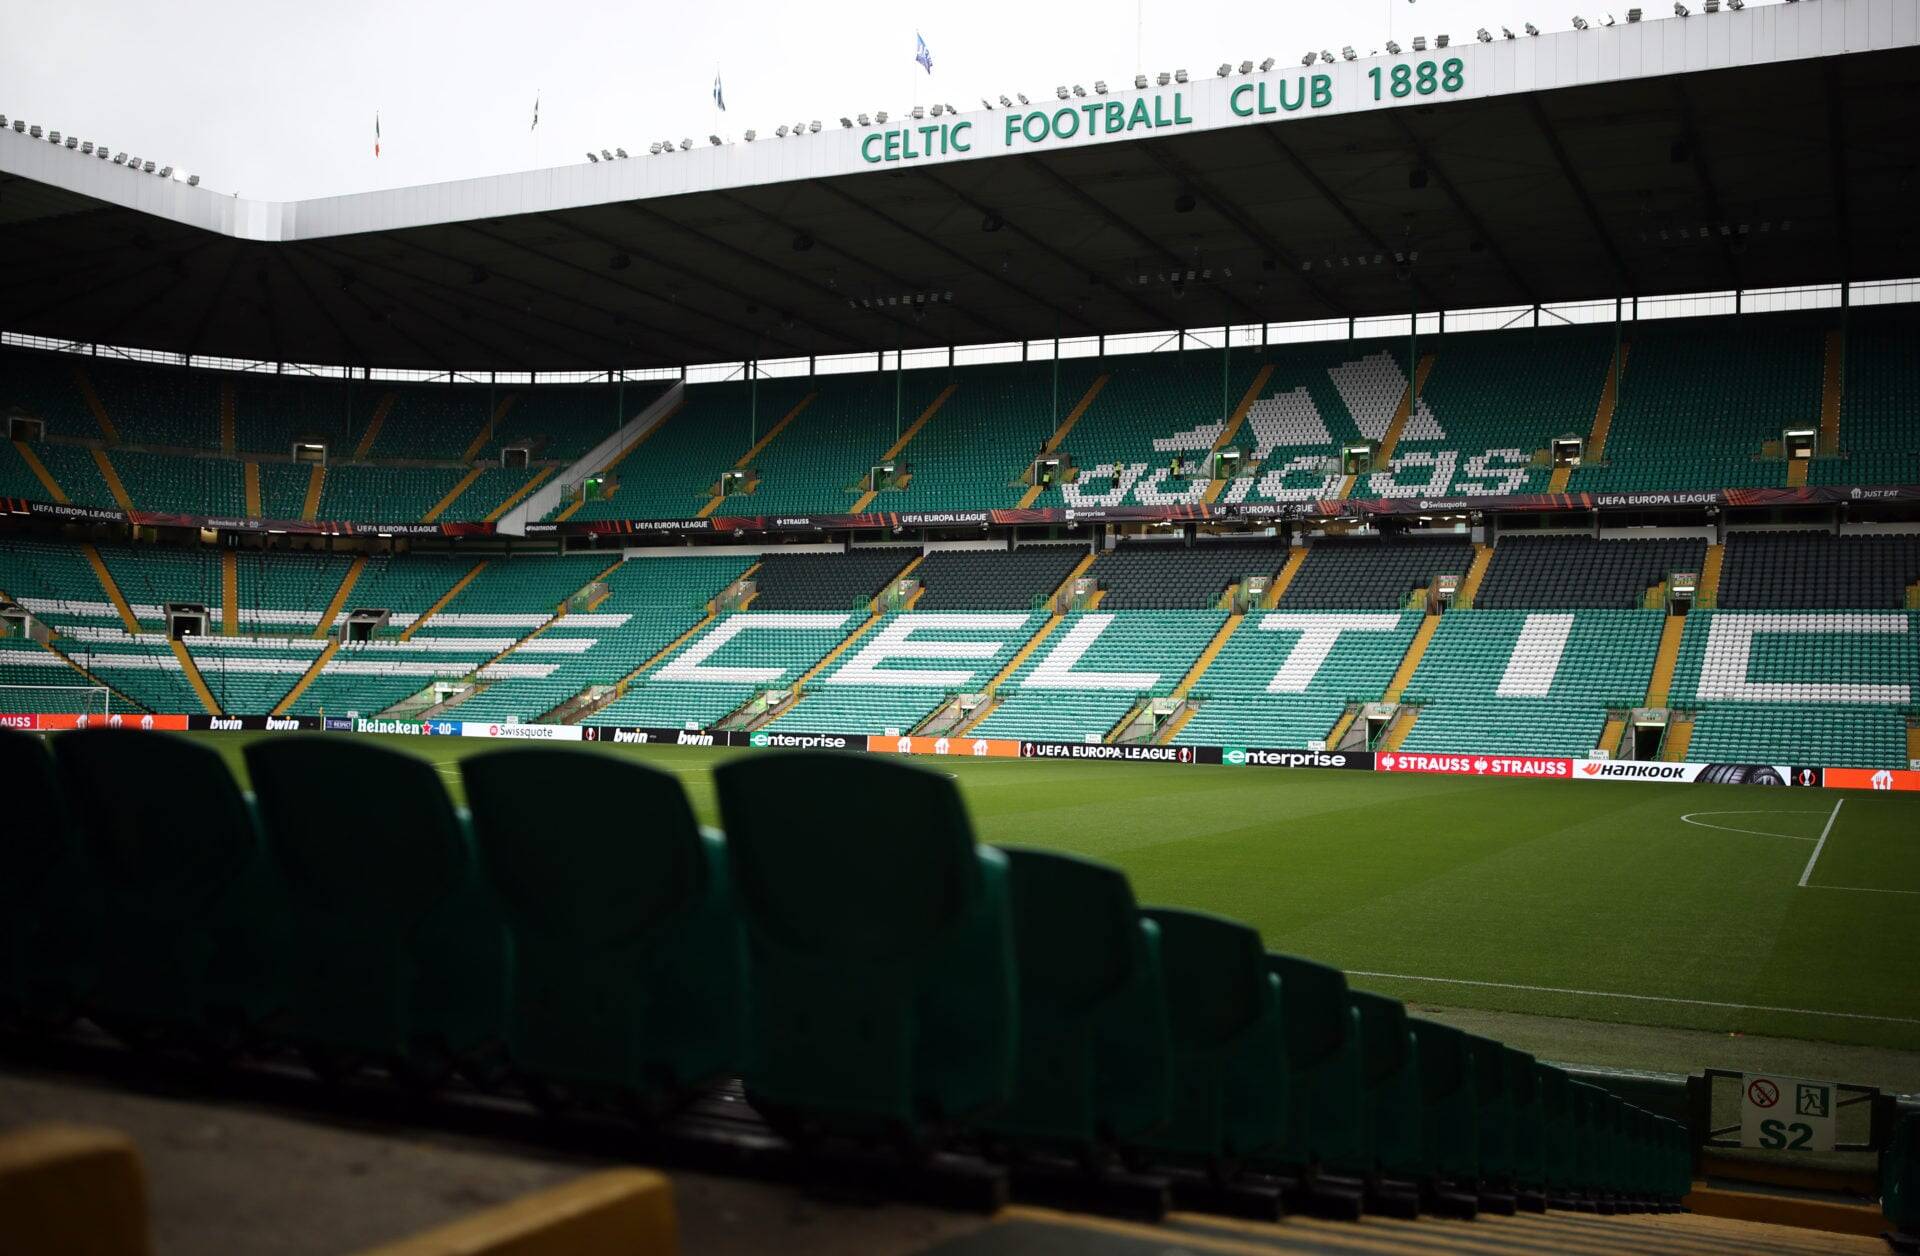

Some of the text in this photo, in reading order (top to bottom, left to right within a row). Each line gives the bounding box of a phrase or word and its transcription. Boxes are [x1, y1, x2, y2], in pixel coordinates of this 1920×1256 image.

[861, 56, 1466, 164] CELTIC FOOTBALL CLUB 1888
[1061, 446, 1533, 507] adidas
[1597, 493, 1717, 505] UEFA EUROPA LEAGUE
[1864, 489, 1898, 498] JUST EAT
[32, 503, 122, 520] UEFA EUROPA LEAGUE
[1240, 505, 1275, 514] EUROPA
[1429, 501, 1467, 509] Swissquote
[635, 520, 707, 530] UEFA EUROPA LEAGUE
[902, 513, 987, 523] UEFA EUROPA LEAGUE
[379, 525, 408, 533] EUROPA
[409, 525, 438, 533] LEAGUE
[648, 611, 1911, 704] CELTIC
[265, 715, 300, 730] bwin
[357, 718, 420, 735] Heineken
[500, 725, 553, 739] Swissquote
[613, 727, 648, 744] bwin
[677, 730, 714, 746] bwin
[750, 733, 846, 749] enterprise
[1036, 745, 1176, 760] UEFA EUROPA LEAGUE
[1223, 750, 1346, 768] enterprise
[1398, 756, 1470, 772] STRAUSS
[1491, 759, 1567, 775] STRAUSS
[1759, 1118, 1813, 1150] S2
